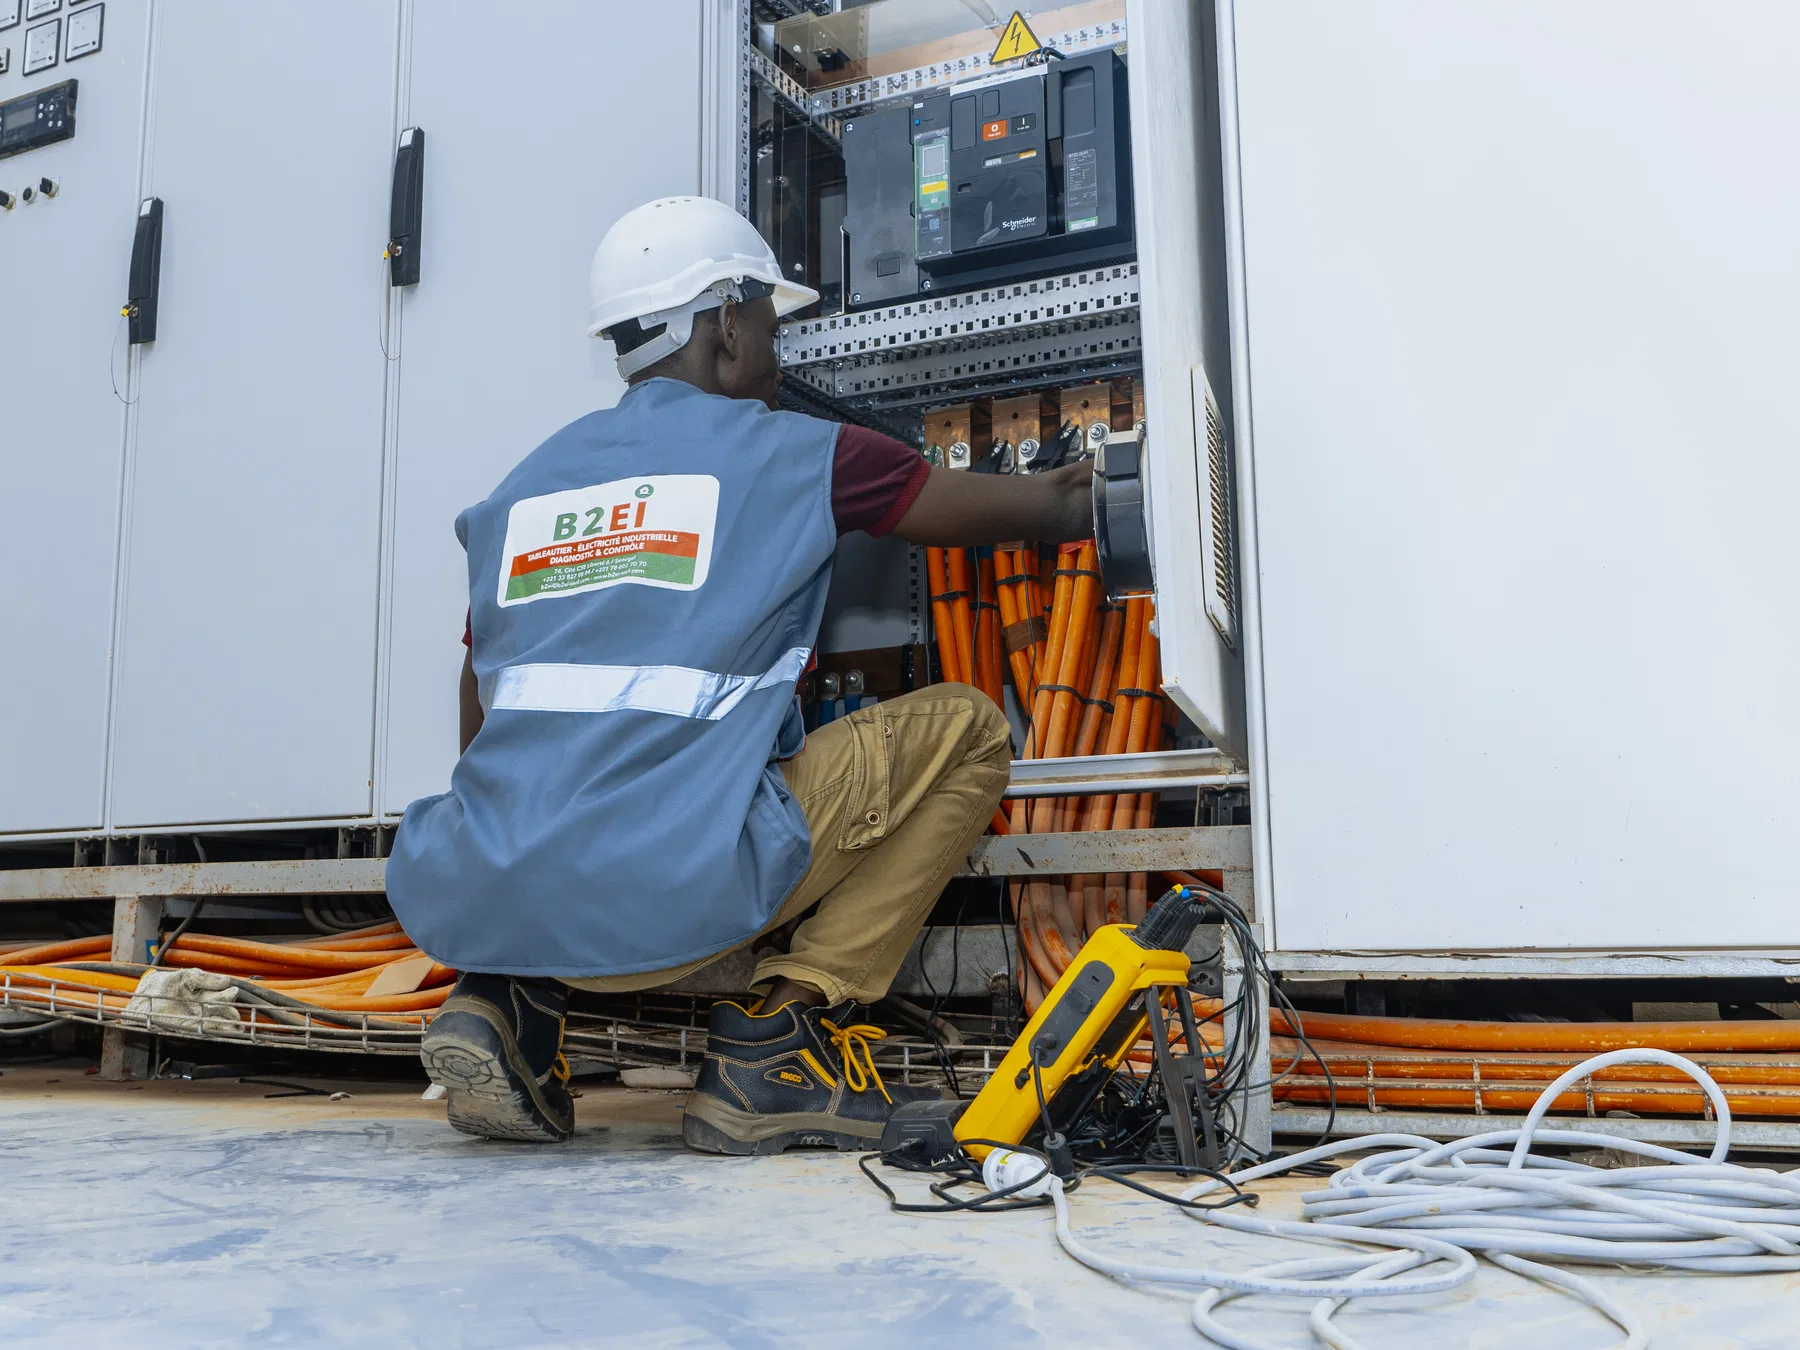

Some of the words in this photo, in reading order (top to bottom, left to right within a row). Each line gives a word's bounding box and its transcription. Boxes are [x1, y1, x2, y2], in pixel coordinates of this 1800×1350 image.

[1002, 216, 1037, 230] Schneider
[528, 546, 572, 562] TABLEAUTIER
[577, 536, 620, 552] ÉLECTRICITÉ
[622, 534, 678, 544] INDUSTRIELLE
[550, 550, 594, 565] DIAGNOSTIC
[603, 542, 644, 556] CONTRÔLE
